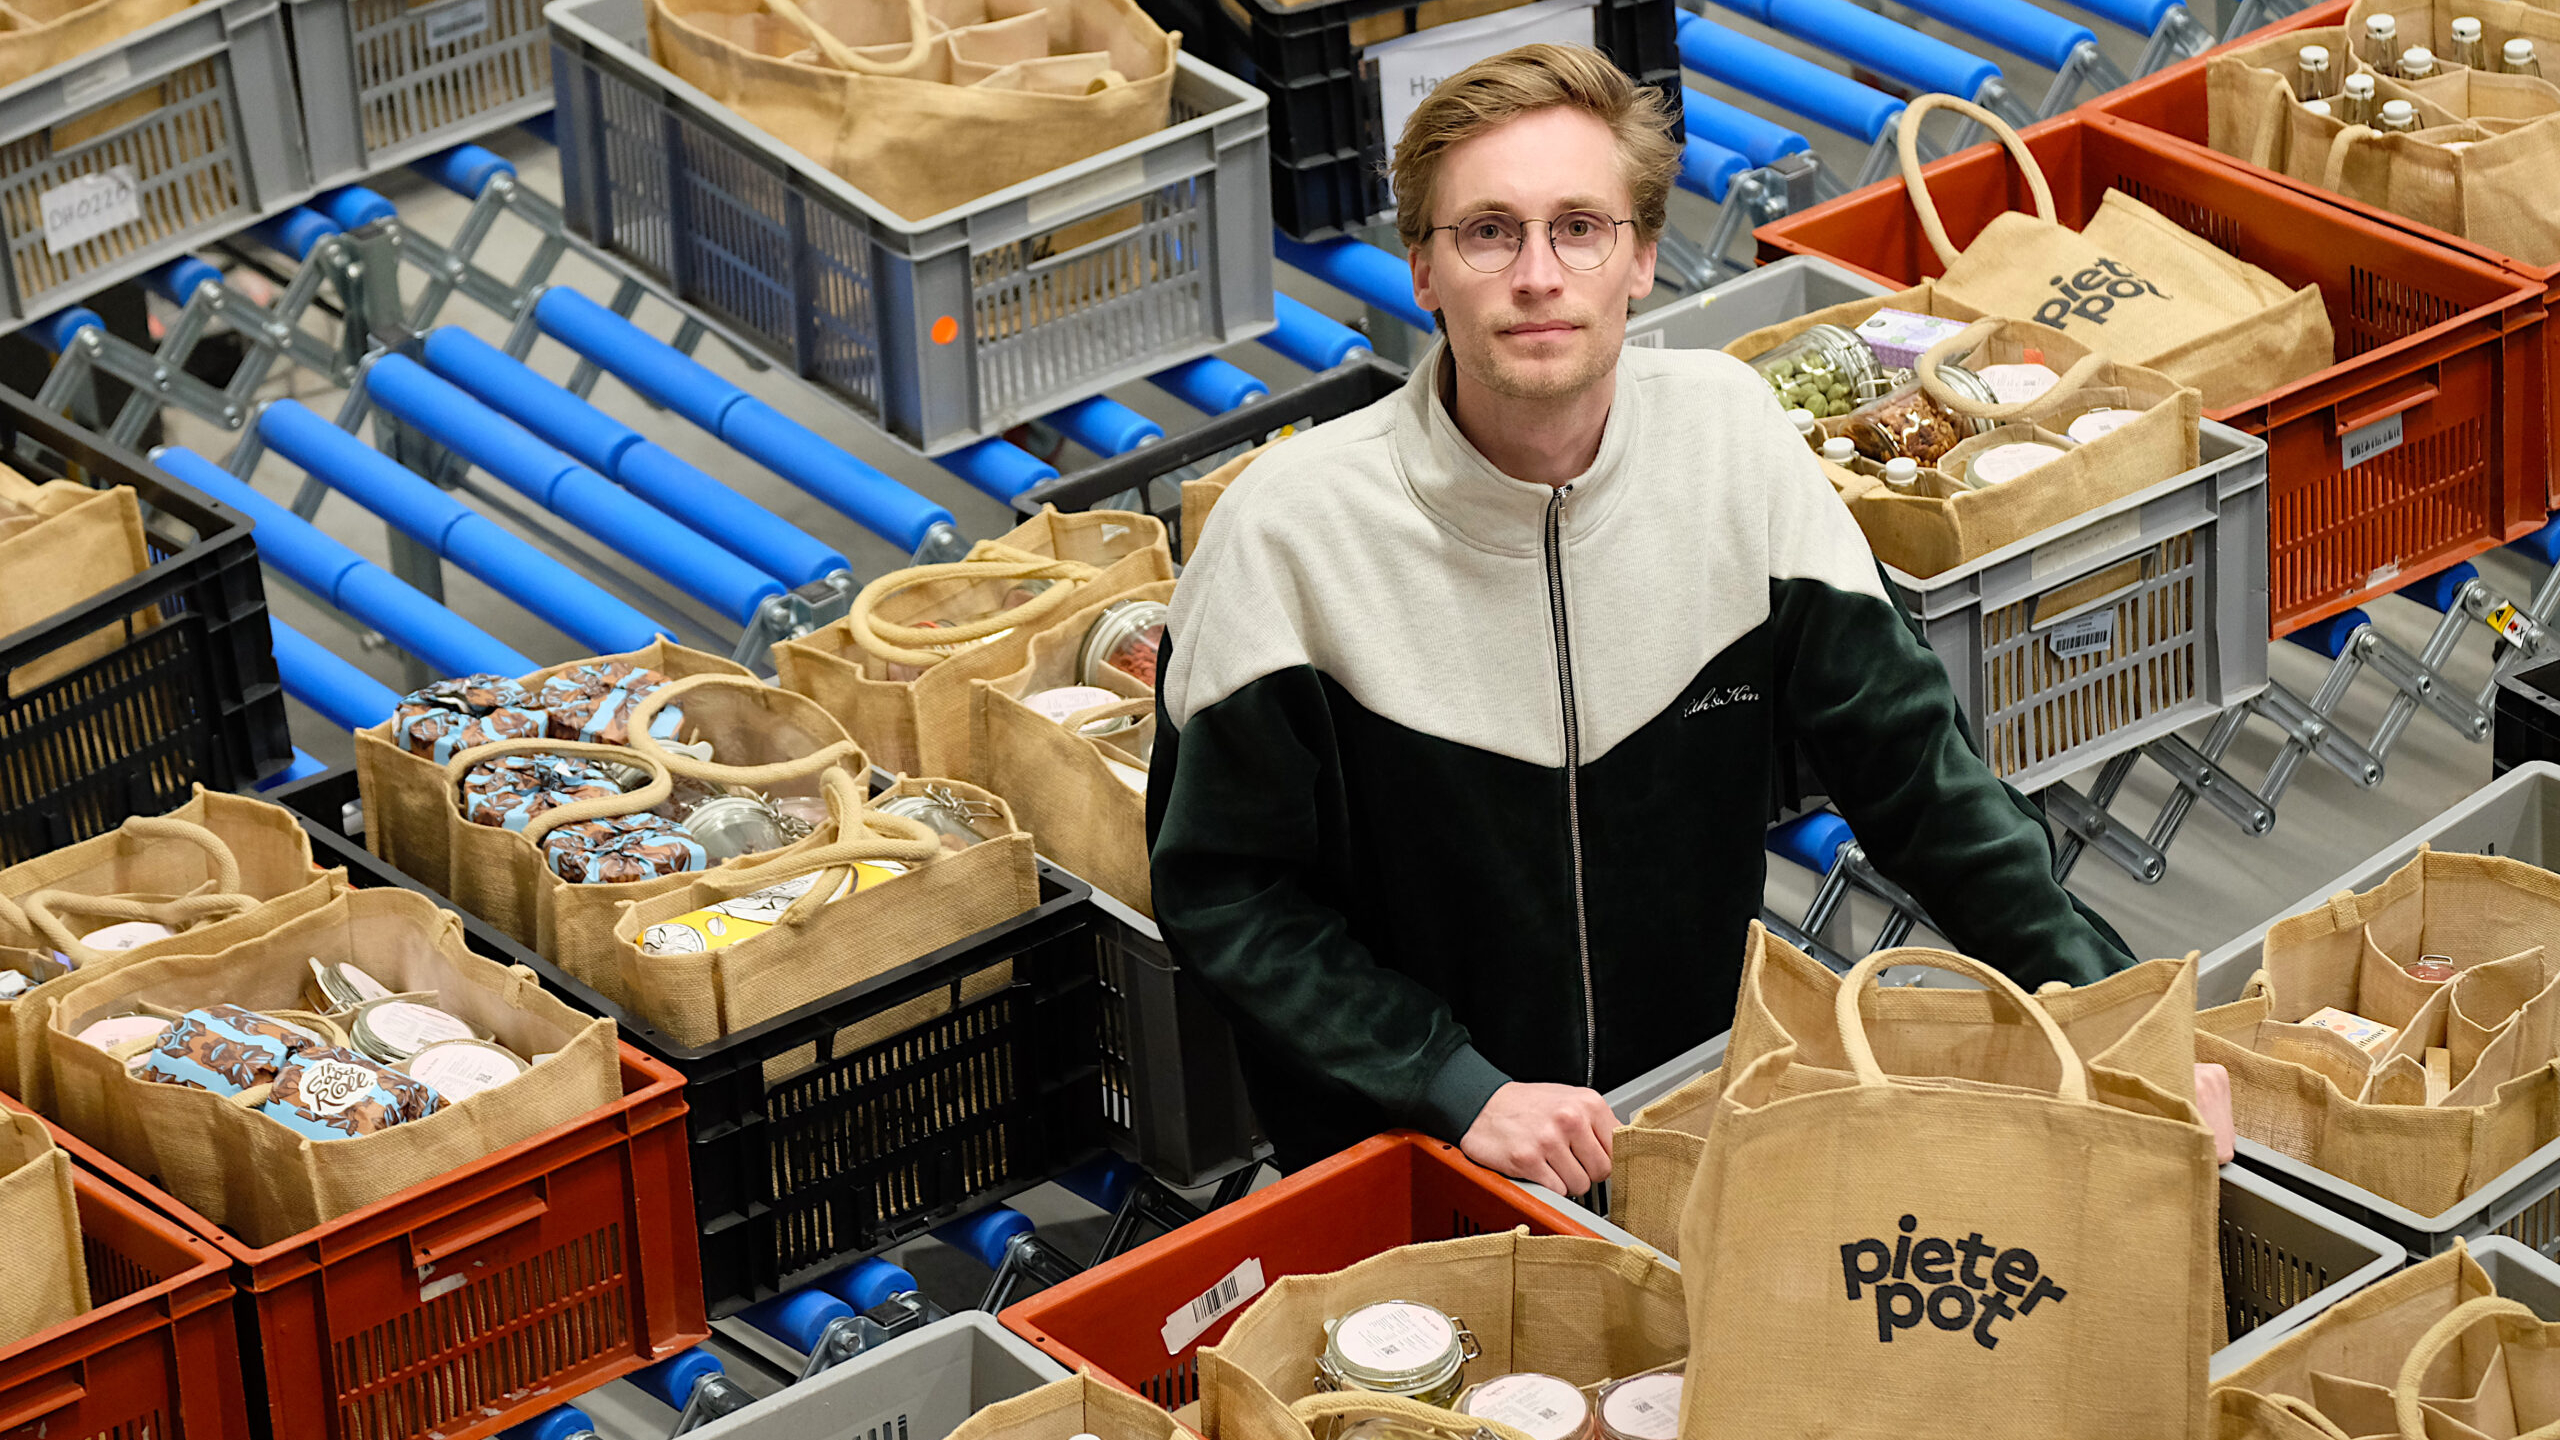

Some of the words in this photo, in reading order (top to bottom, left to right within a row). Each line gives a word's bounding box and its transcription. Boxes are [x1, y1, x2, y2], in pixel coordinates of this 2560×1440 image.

[1410, 75, 1447, 97] Ha
[306, 1066, 359, 1095] Good
[1840, 1214, 2068, 1316] pieter
[1876, 1282, 2016, 1350] pot
